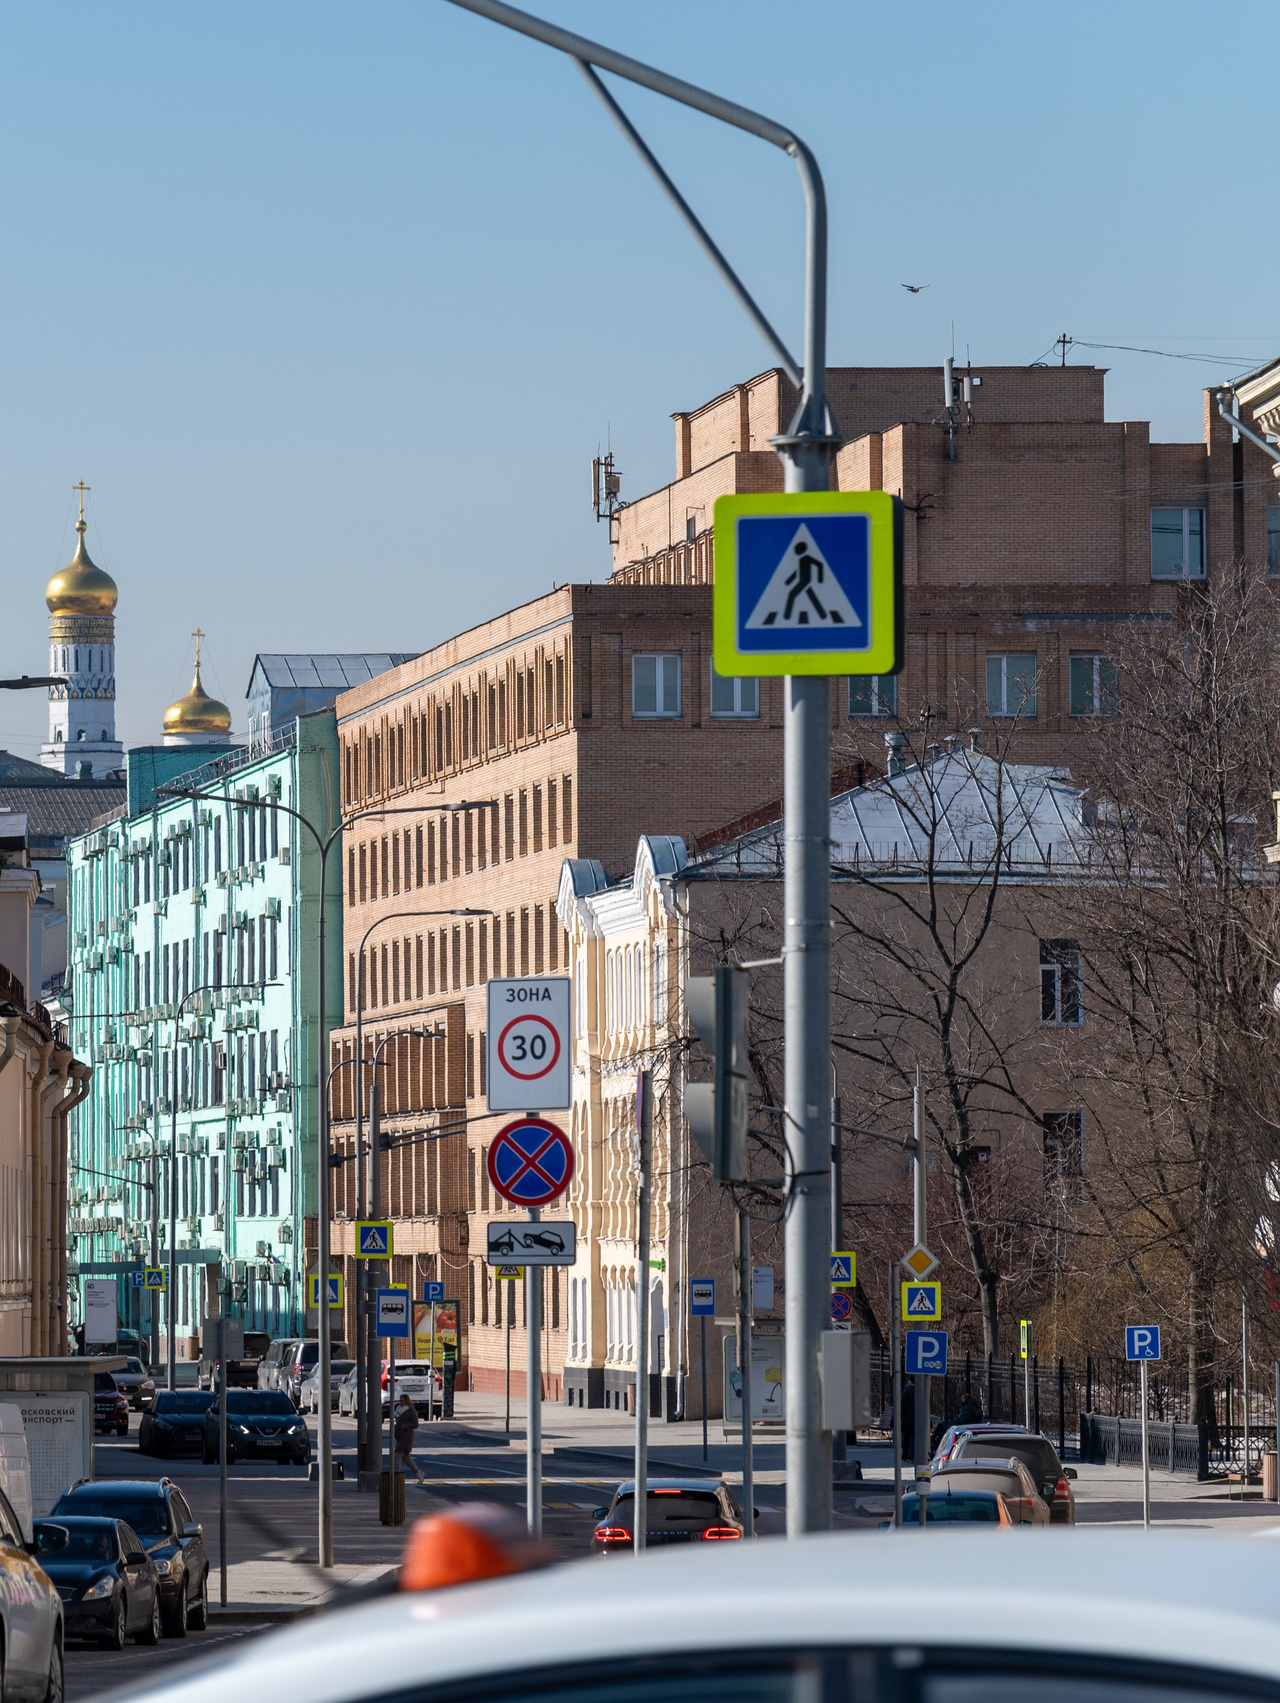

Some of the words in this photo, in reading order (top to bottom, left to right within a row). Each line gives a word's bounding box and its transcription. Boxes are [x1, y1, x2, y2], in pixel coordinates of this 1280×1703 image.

[506, 987, 552, 1003] ЗОНА
[511, 1034, 547, 1061] 30
[135, 1273, 144, 1285] P
[429, 1284, 440, 1299] P
[1134, 1329, 1152, 1355] P
[917, 1336, 940, 1368] P
[21, 1407, 75, 1416] осковский
[23, 1417, 63, 1425] анспорт
